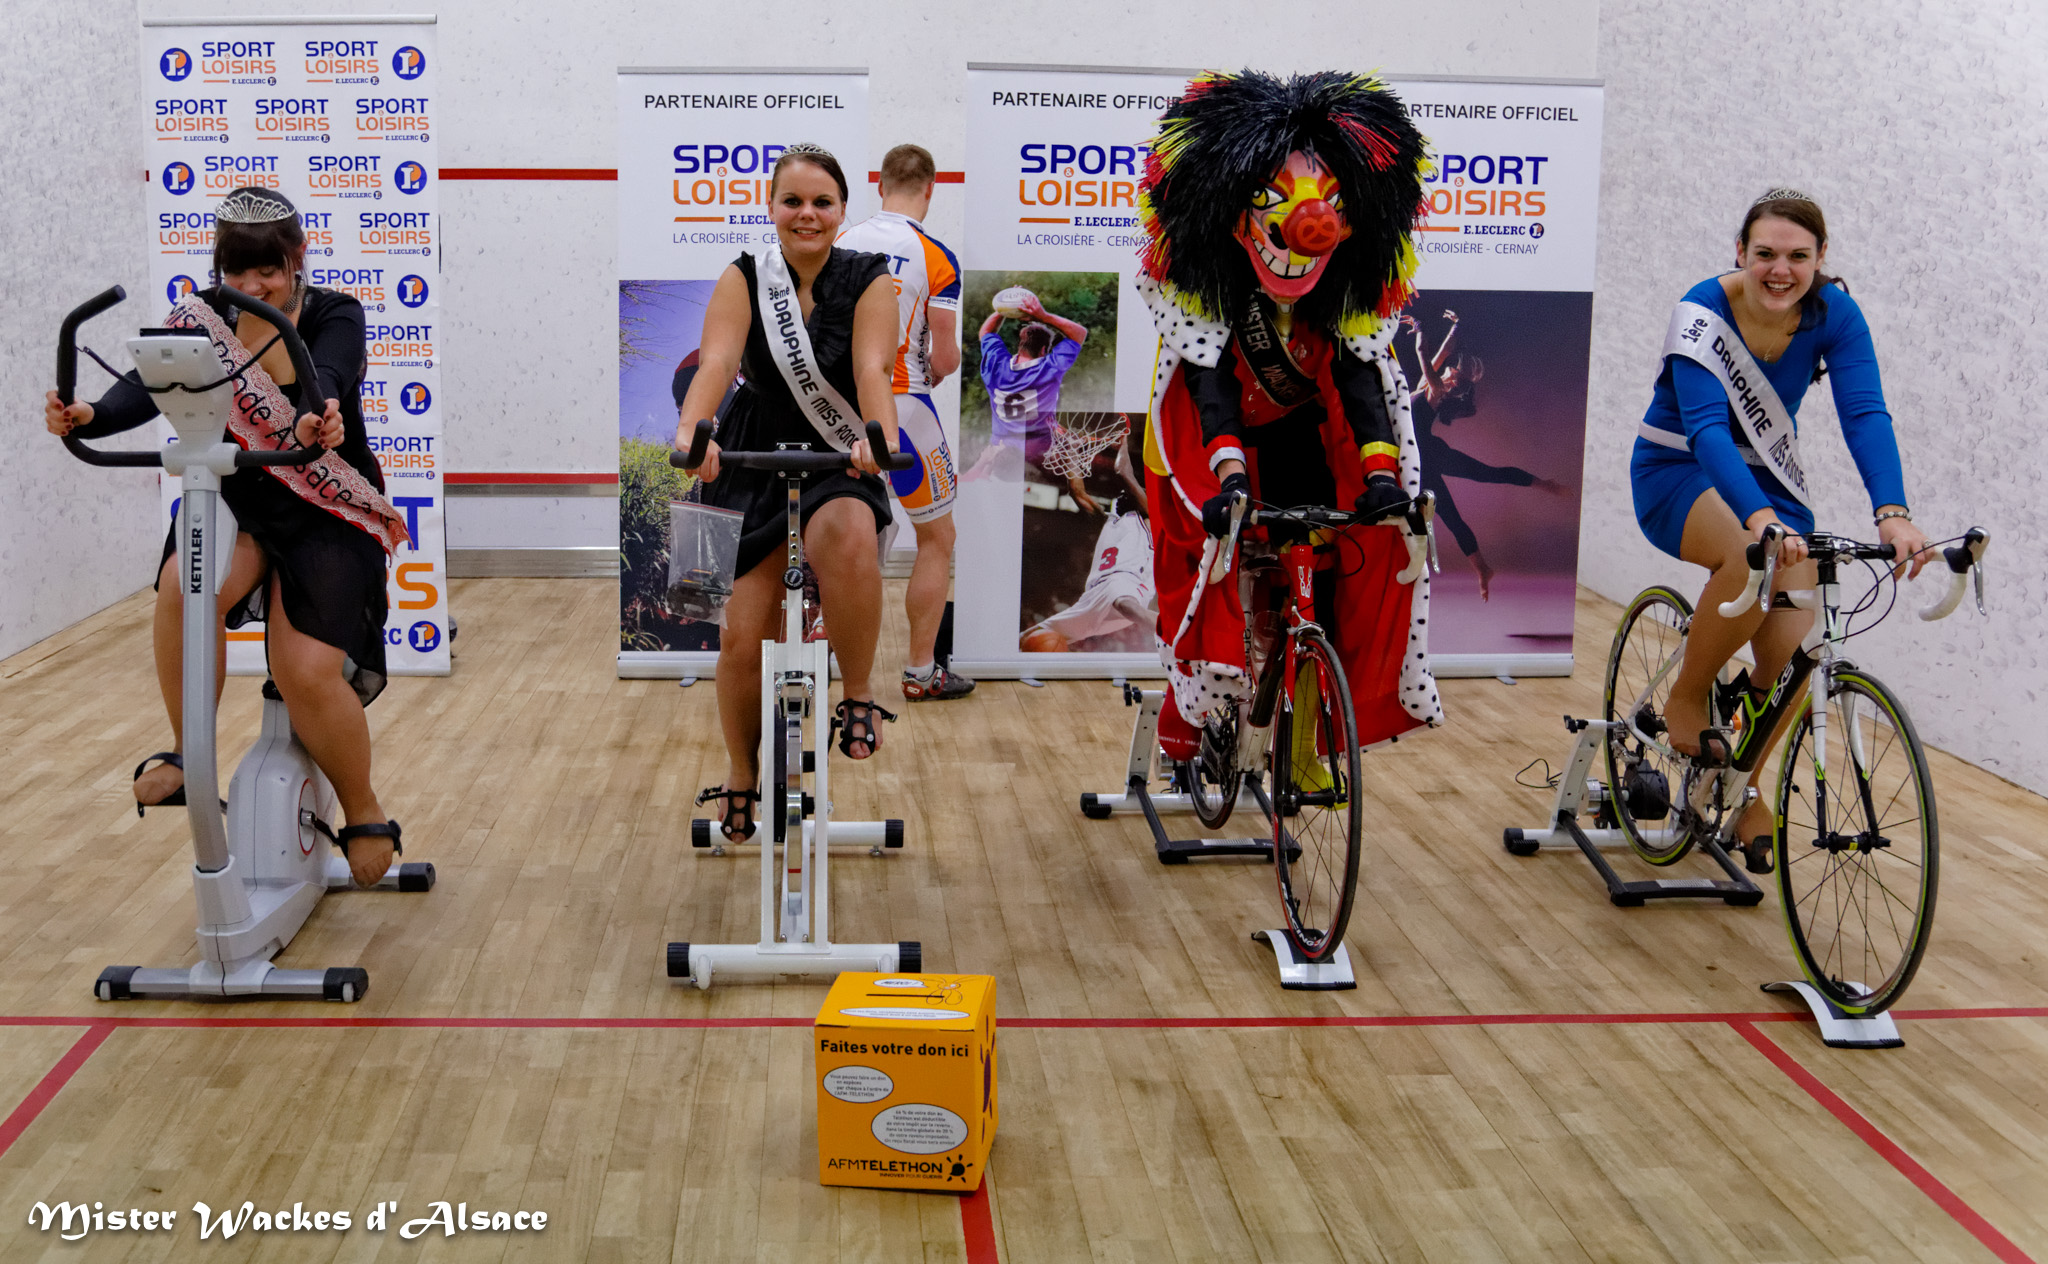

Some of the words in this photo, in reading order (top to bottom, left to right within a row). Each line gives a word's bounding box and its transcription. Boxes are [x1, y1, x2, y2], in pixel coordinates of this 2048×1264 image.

[202, 41, 275, 58] SPORT
[305, 41, 378, 57] SPORT
[202, 60, 276, 74] LOISIRS
[305, 59, 379, 74] LOISIRS
[155, 99, 227, 115] SPORT
[255, 99, 328, 115] SPORT
[356, 98, 429, 114] SPORT
[644, 94, 758, 109] PARTENAIRE
[763, 94, 844, 109] OFFICIEL
[993, 91, 1107, 108] PARTENAIRE
[1113, 94, 1177, 110] OFFICI
[1400, 104, 1496, 119] ARTENAIRE
[1502, 106, 1578, 121] OFFICIEL
[155, 117, 229, 132] LOISIRS
[256, 117, 330, 131] LOISIRS
[356, 116, 430, 131] LOISIRS
[204, 156, 279, 172] SPORT
[308, 156, 381, 172] SPORT
[673, 144, 787, 174] SPOR
[204, 174, 280, 188] LOISIRS
[308, 174, 382, 188] LOISIRS
[673, 179, 772, 205] LOISI
[1019, 179, 1137, 207] LOISIR
[1431, 189, 1546, 216] OISIRS
[159, 213, 217, 229] SPOR
[360, 213, 430, 228] SPORT
[1074, 217, 1139, 228] E.LECLERC
[360, 230, 431, 245] LOISIRS
[673, 233, 687, 244] LA
[691, 230, 750, 244] CROISIÈRE
[1463, 225, 1526, 235] E.LECLERC
[1017, 234, 1032, 245] LA
[1035, 233, 1095, 246] CROISIÈRE
[1107, 235, 1155, 247] CERNAY
[1427, 241, 1483, 254] CROISIÈRE
[1495, 243, 1539, 254] CERNAY
[312, 269, 384, 285] SPORT
[768, 286, 790, 301] 3ème
[366, 325, 432, 341] SPORT
[773, 298, 819, 396] DAUPHINE
[1711, 335, 1773, 438] DAUPHINE
[811, 397, 843, 428] MISS
[1004, 393, 1026, 419] 6
[367, 436, 434, 452] SPORT
[376, 454, 435, 468] OISIRS
[930, 448, 950, 499] LOISIRS
[190, 527, 203, 594] KETTLER
[1098, 546, 1119, 571] 3
[821, 1040, 867, 1054] Faites
[872, 1043, 913, 1056] votre
[918, 1042, 946, 1056] don
[951, 1044, 969, 1057] ici
